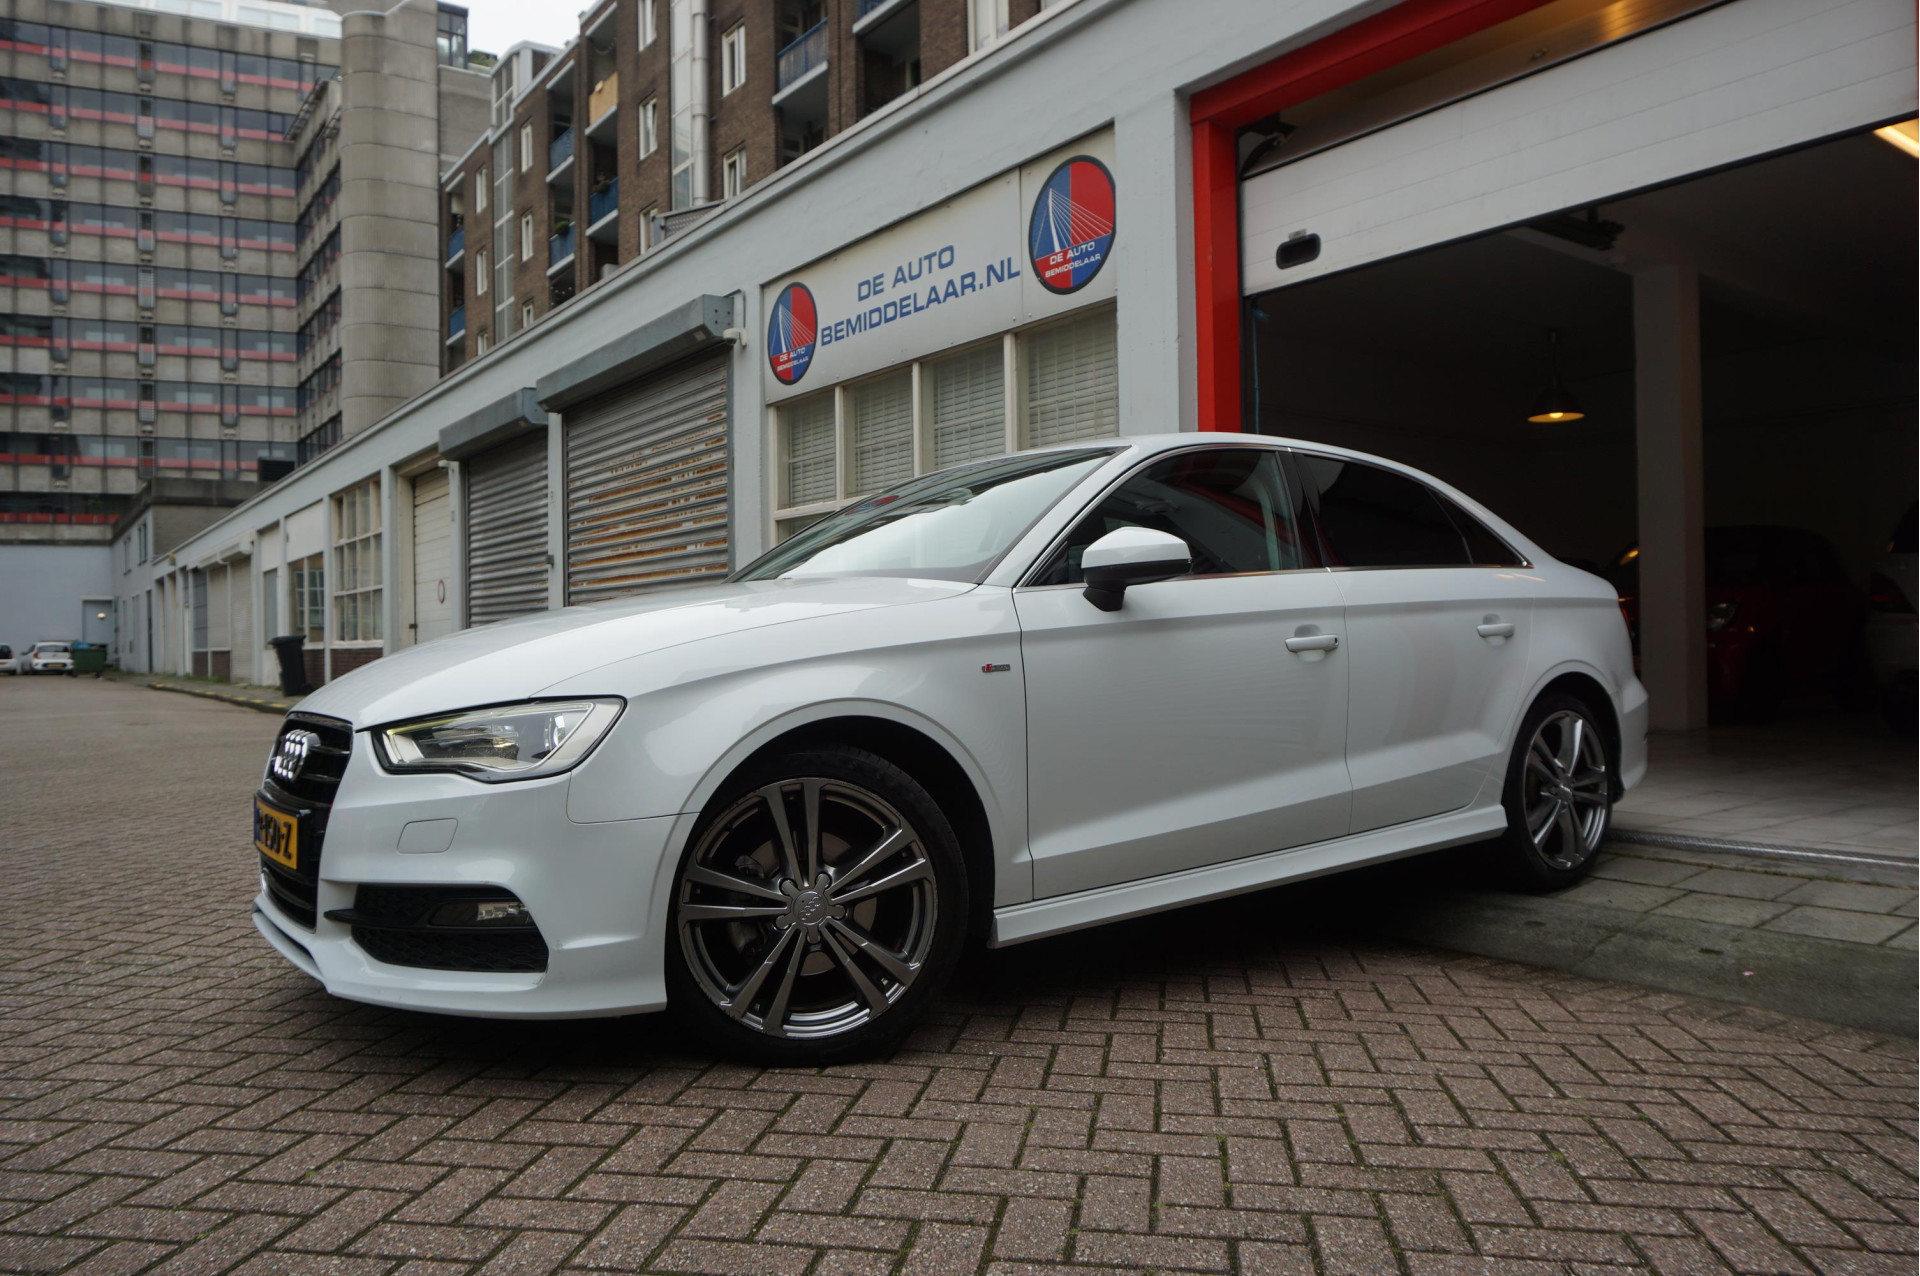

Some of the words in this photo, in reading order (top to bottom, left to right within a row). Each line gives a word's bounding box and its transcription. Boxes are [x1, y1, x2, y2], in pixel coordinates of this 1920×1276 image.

[857, 272, 885, 302] DE
[891, 244, 955, 289] AUTO
[1044, 253, 1101, 278] BEMIDDELAAR
[1049, 252, 1064, 265] DE
[1066, 241, 1096, 260] AUTO
[820, 256, 1021, 347] BEMIDDELAAR.NL
